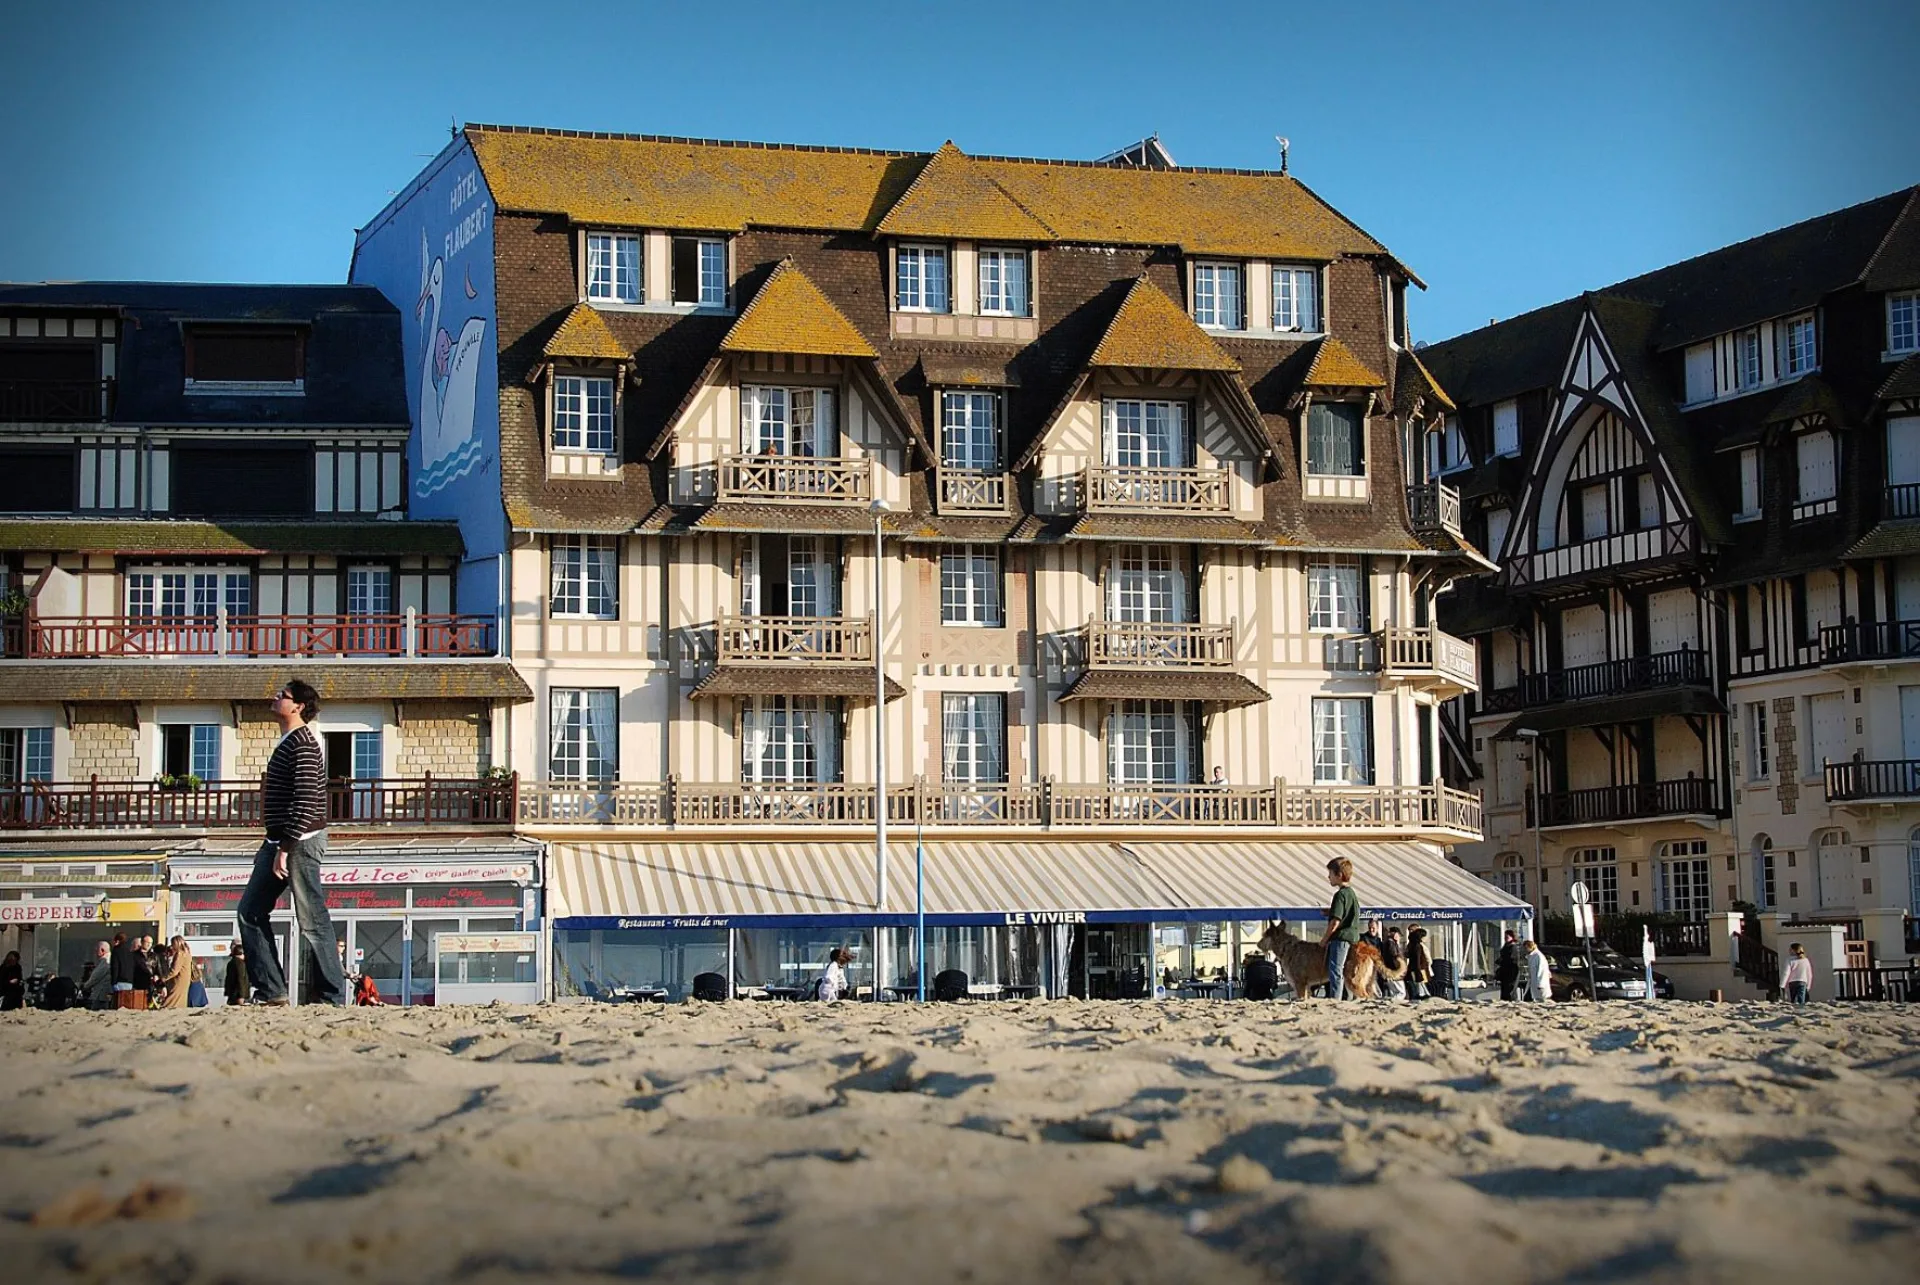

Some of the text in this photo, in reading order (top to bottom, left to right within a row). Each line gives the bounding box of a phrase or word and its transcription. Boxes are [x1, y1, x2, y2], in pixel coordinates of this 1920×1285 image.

[450, 169, 478, 215] HÔTEL
[445, 201, 488, 262] FLAUBERT
[456, 331, 480, 372] TROUVILLE
[1, 906, 95, 920] CREPERIE
[1005, 911, 1087, 925] LE VIVIER
[1391, 910, 1426, 920] Crustacés
[1432, 911, 1464, 919] Poissons
[618, 918, 666, 928] Restaurant
[673, 918, 700, 927] Fruits
[701, 916, 711, 927] de
[713, 918, 729, 926] mer
